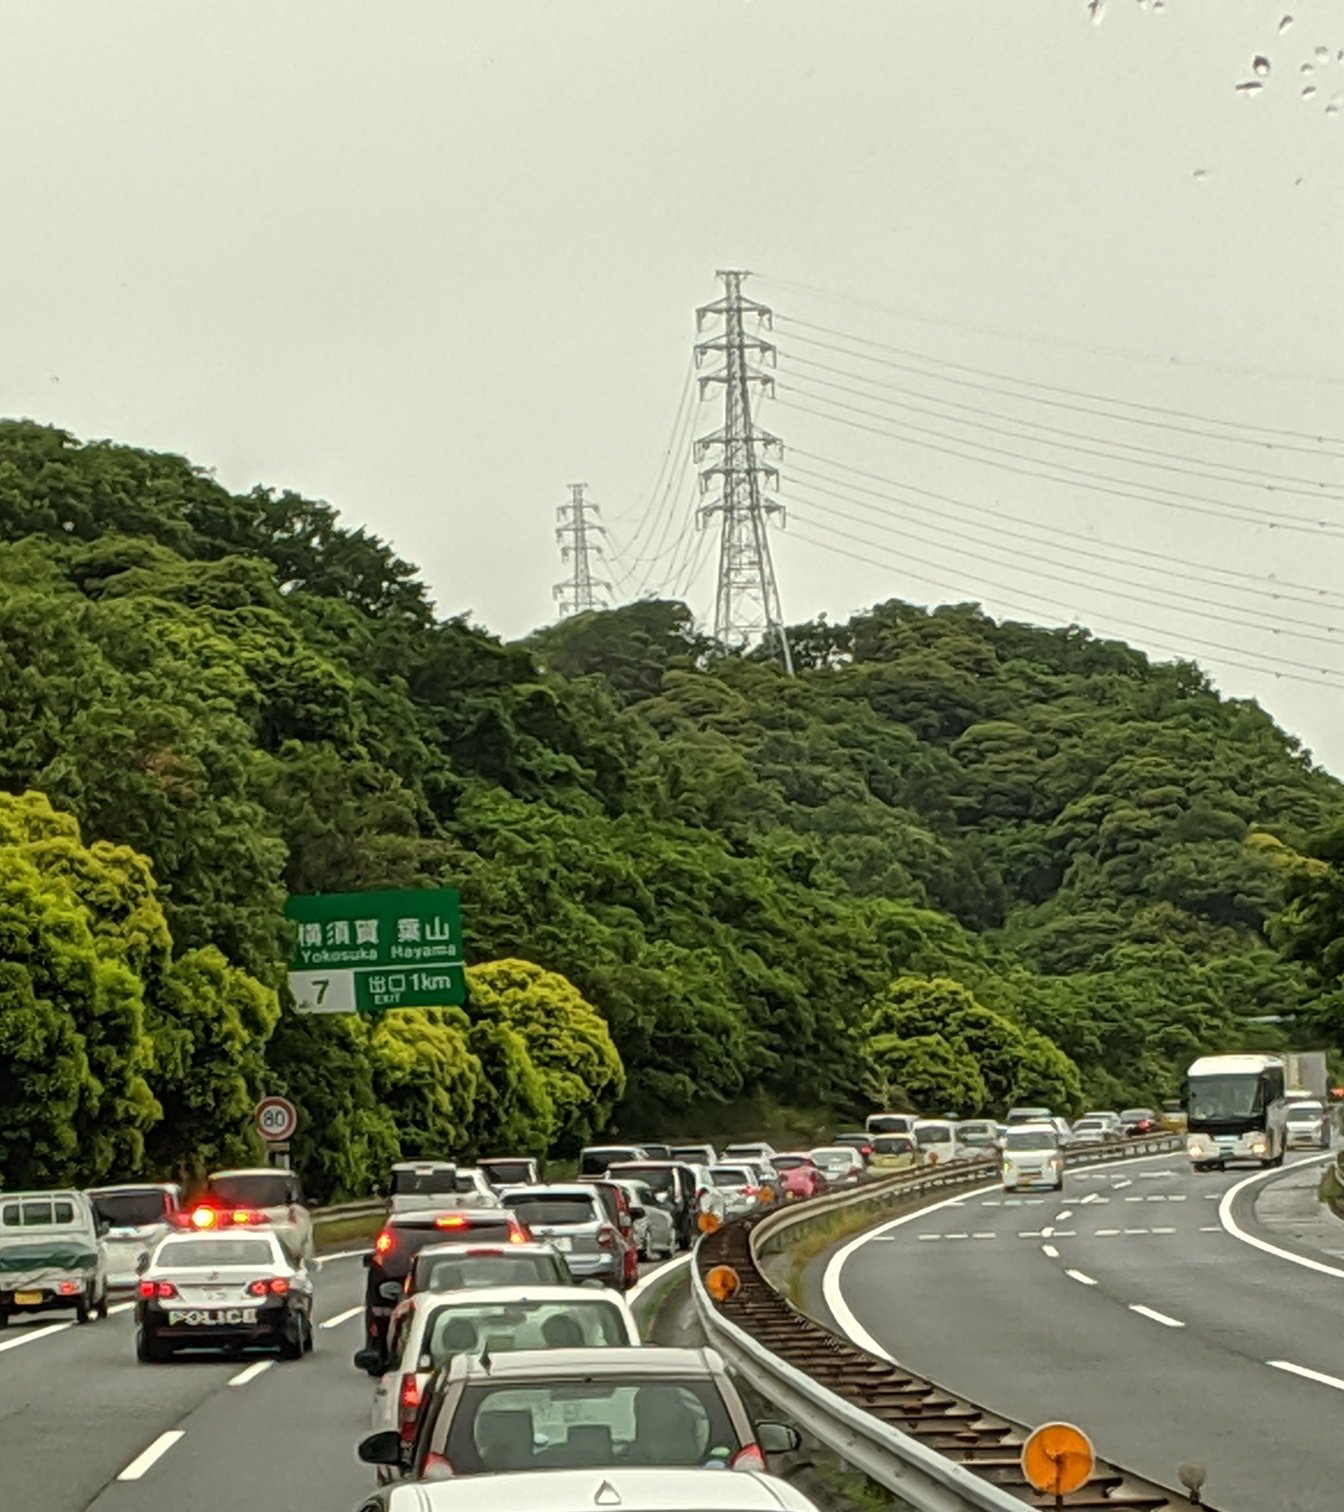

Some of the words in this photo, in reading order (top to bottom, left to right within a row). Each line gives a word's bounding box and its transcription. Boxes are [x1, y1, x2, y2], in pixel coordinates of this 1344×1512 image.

[301, 948, 378, 963] Yokosuka
[390, 944, 456, 960] Hayama
[311, 979, 329, 1005] 7
[368, 974, 405, 993] 出口
[263, 1109, 285, 1128] 80
[169, 1309, 257, 1326] POLICE
